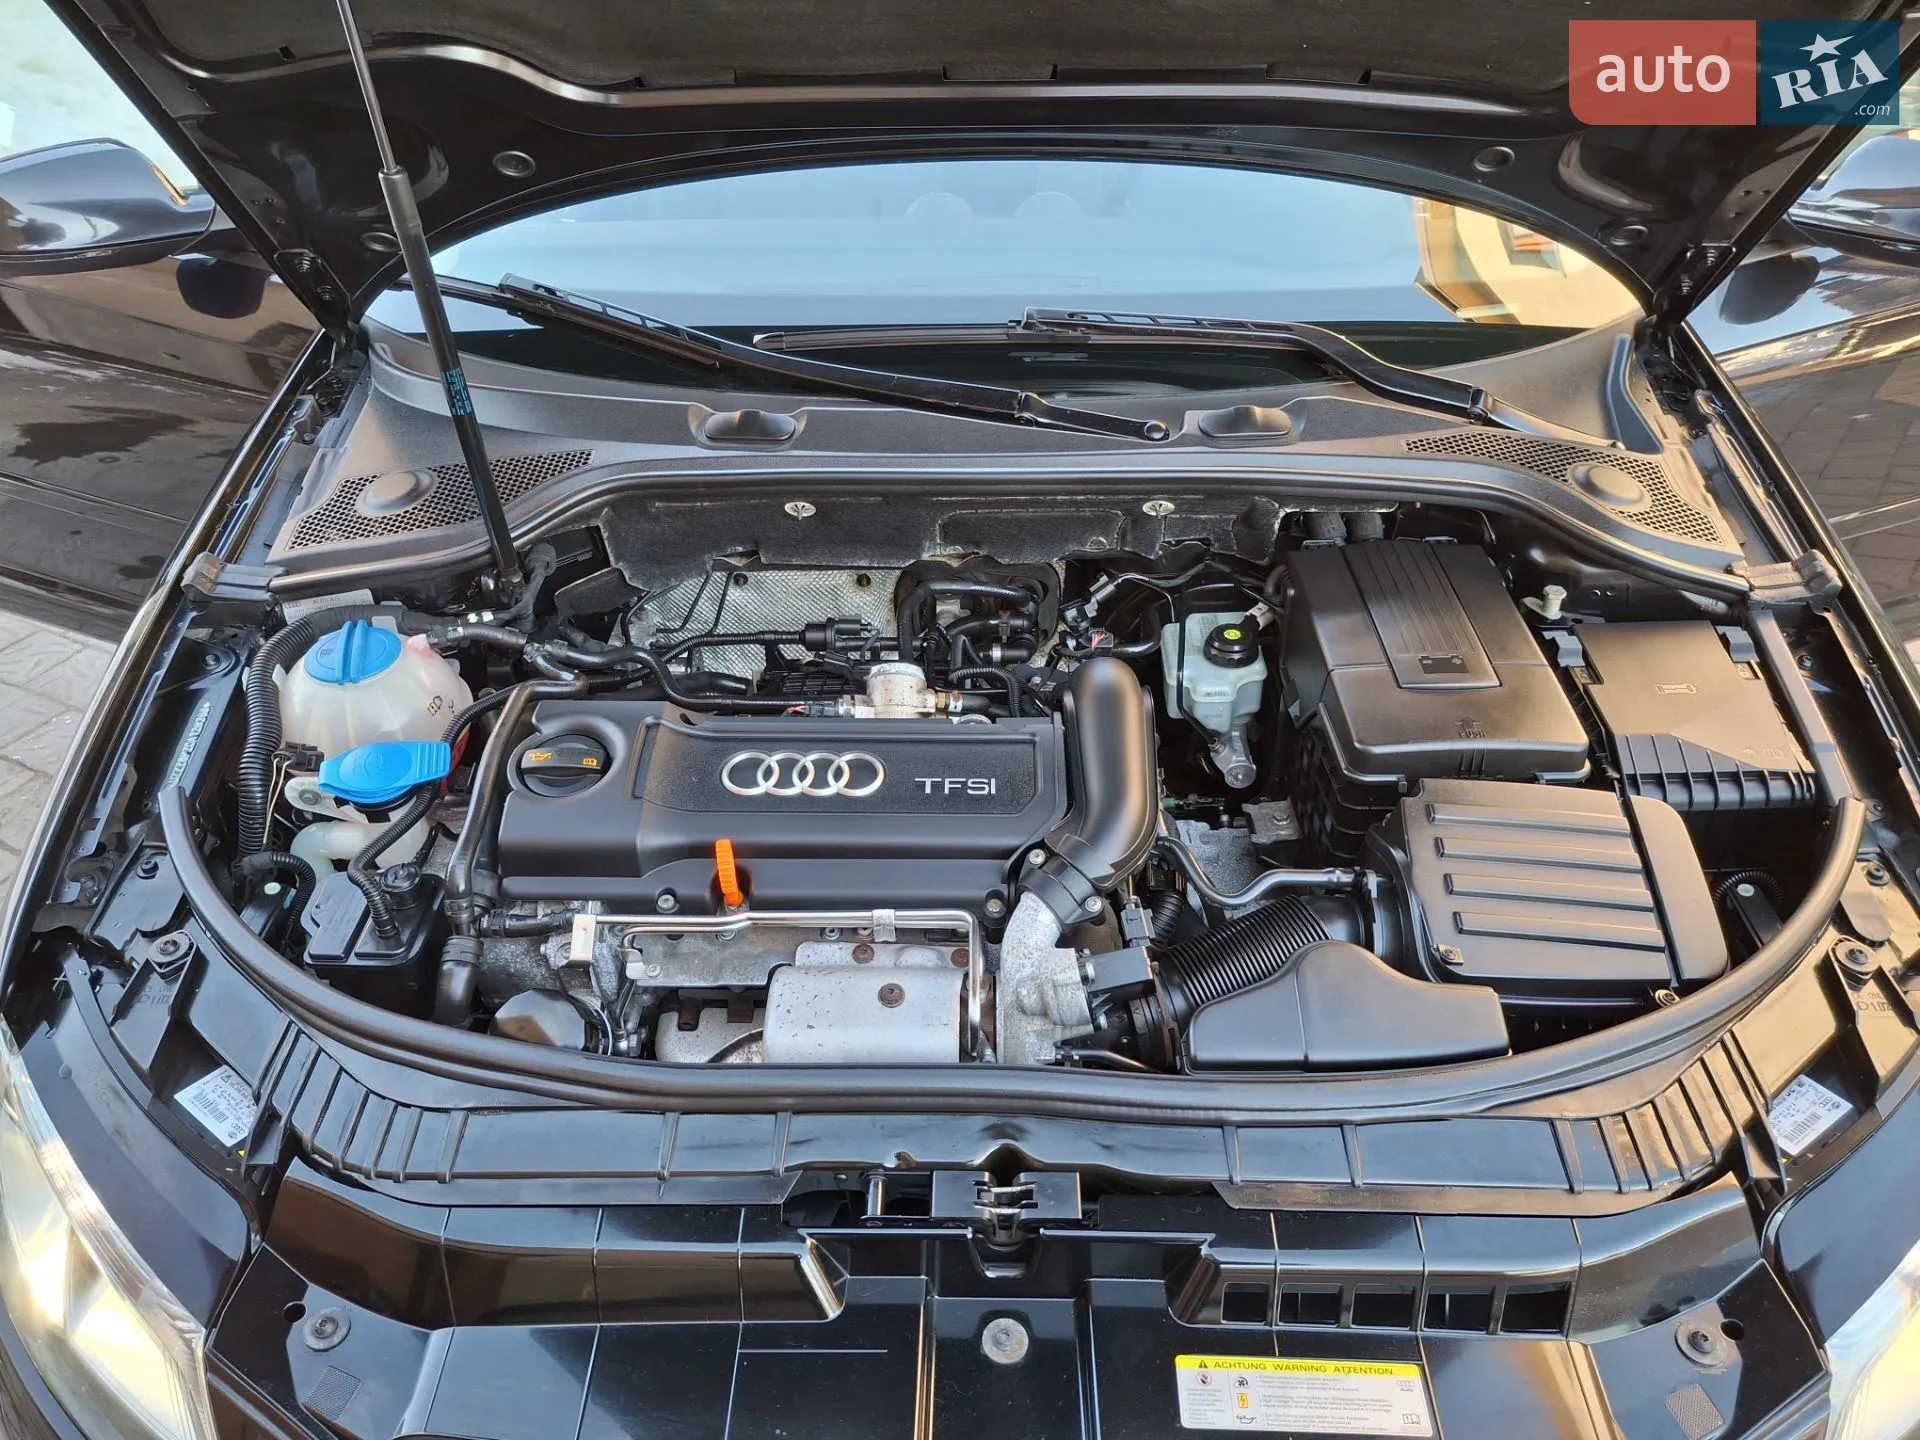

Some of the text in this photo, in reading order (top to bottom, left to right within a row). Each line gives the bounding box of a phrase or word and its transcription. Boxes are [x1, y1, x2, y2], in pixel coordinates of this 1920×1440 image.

[914, 777, 997, 795] TFSI
[1213, 1361, 1393, 1376] ACHTUNG WARNING ATTENTION
